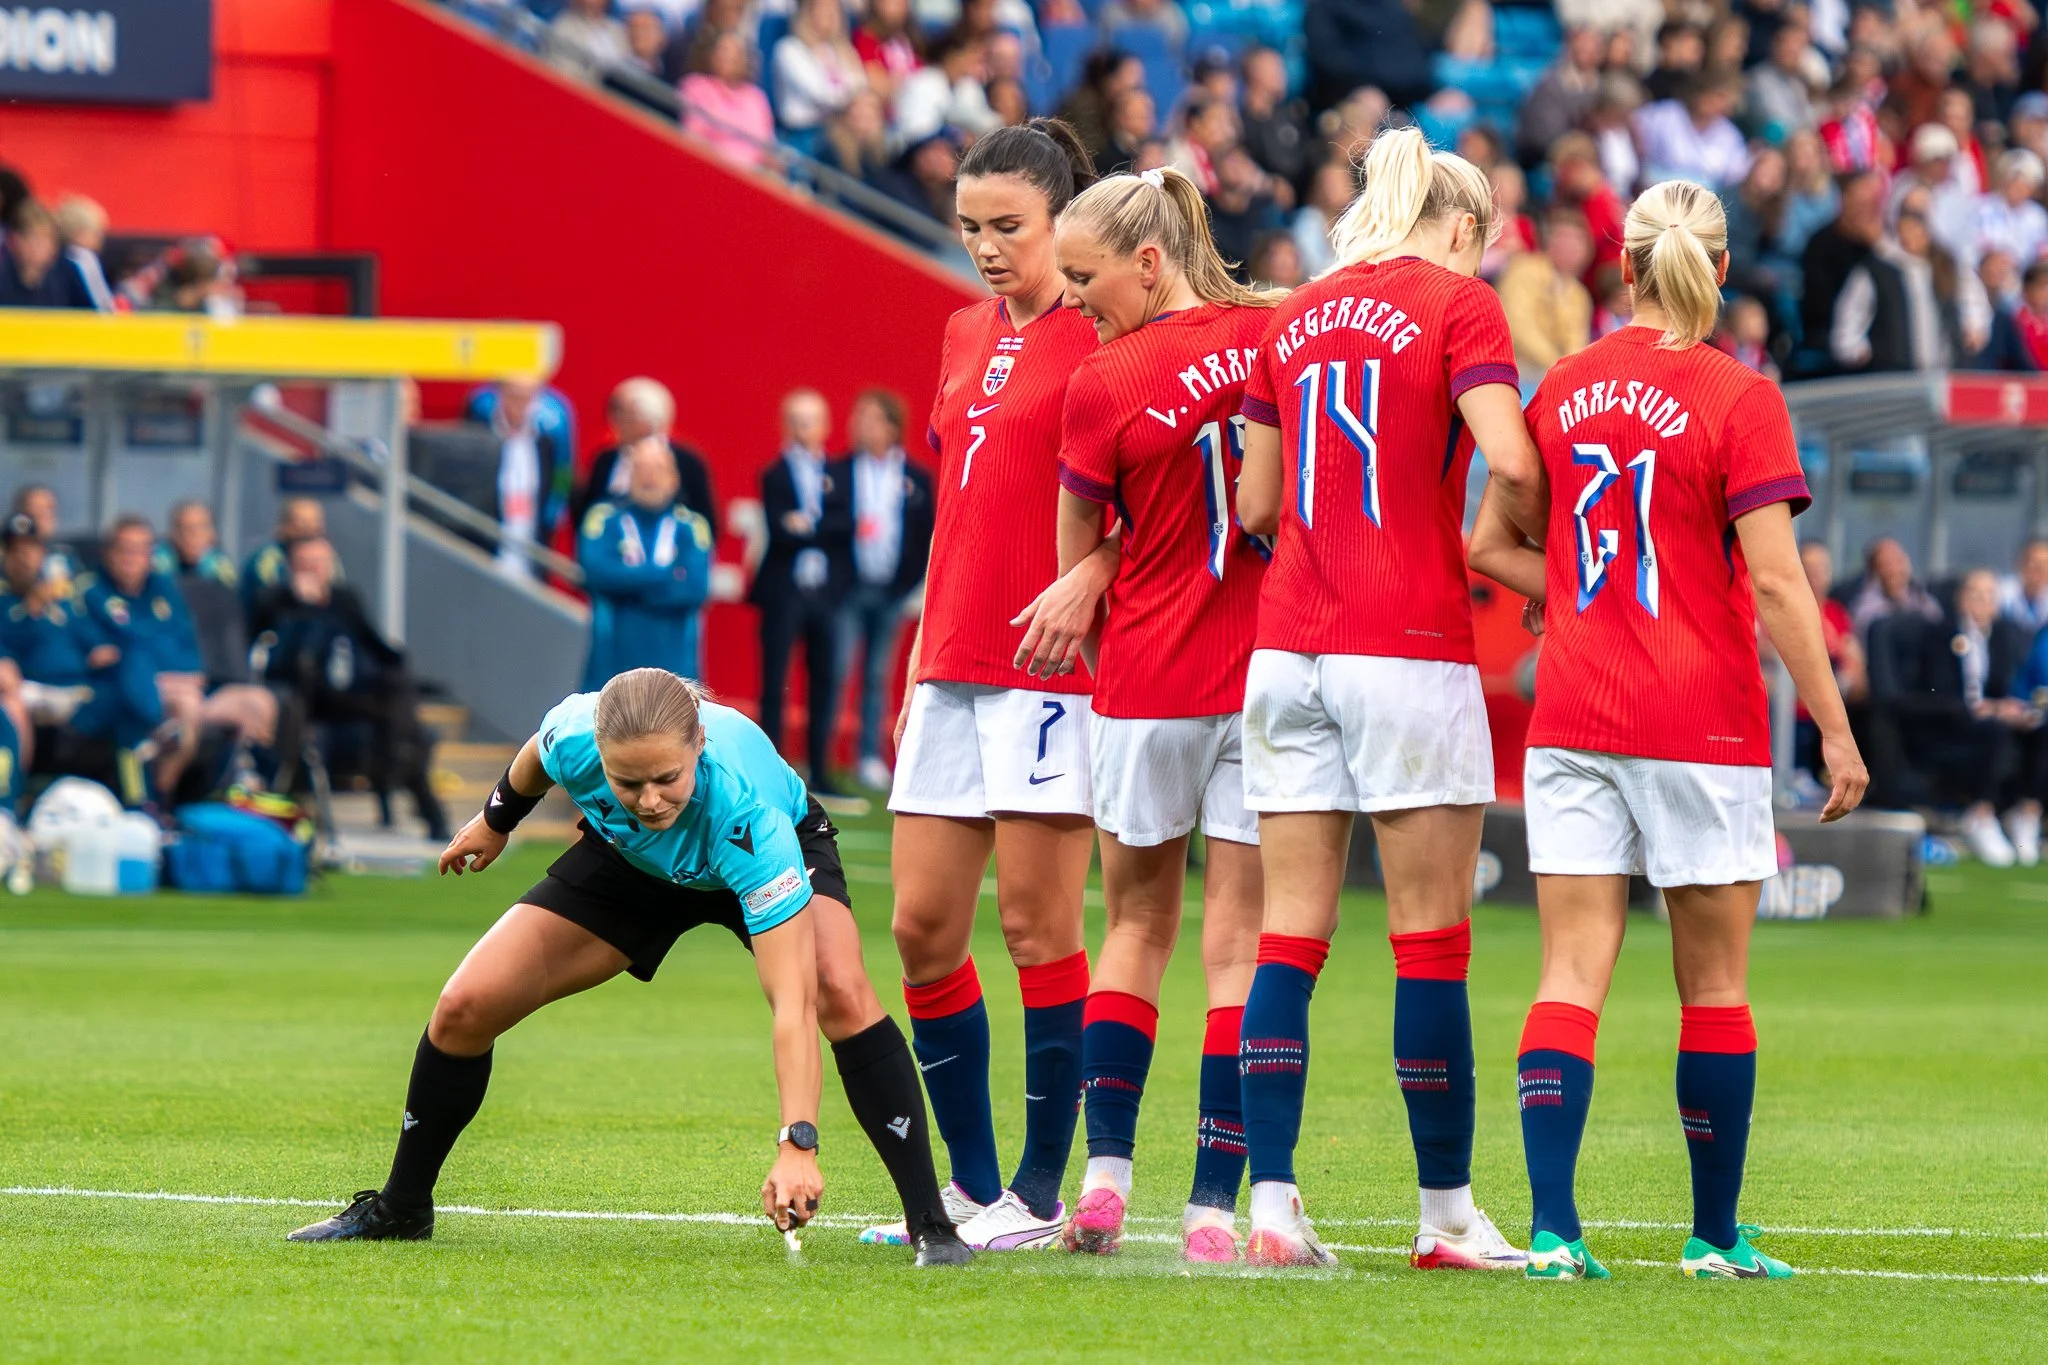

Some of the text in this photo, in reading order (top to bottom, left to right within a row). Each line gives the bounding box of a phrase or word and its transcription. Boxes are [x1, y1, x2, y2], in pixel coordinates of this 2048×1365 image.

[1275, 296, 1422, 364] HEGERBERG
[1145, 406, 1188, 429] V.
[1558, 379, 1690, 439] NAALSUND
[960, 425, 986, 490] 7
[1293, 358, 1382, 530] 14
[1572, 443, 1659, 620] 21
[1037, 700, 1067, 763] 7
[747, 873, 798, 907] FOUNDATION
